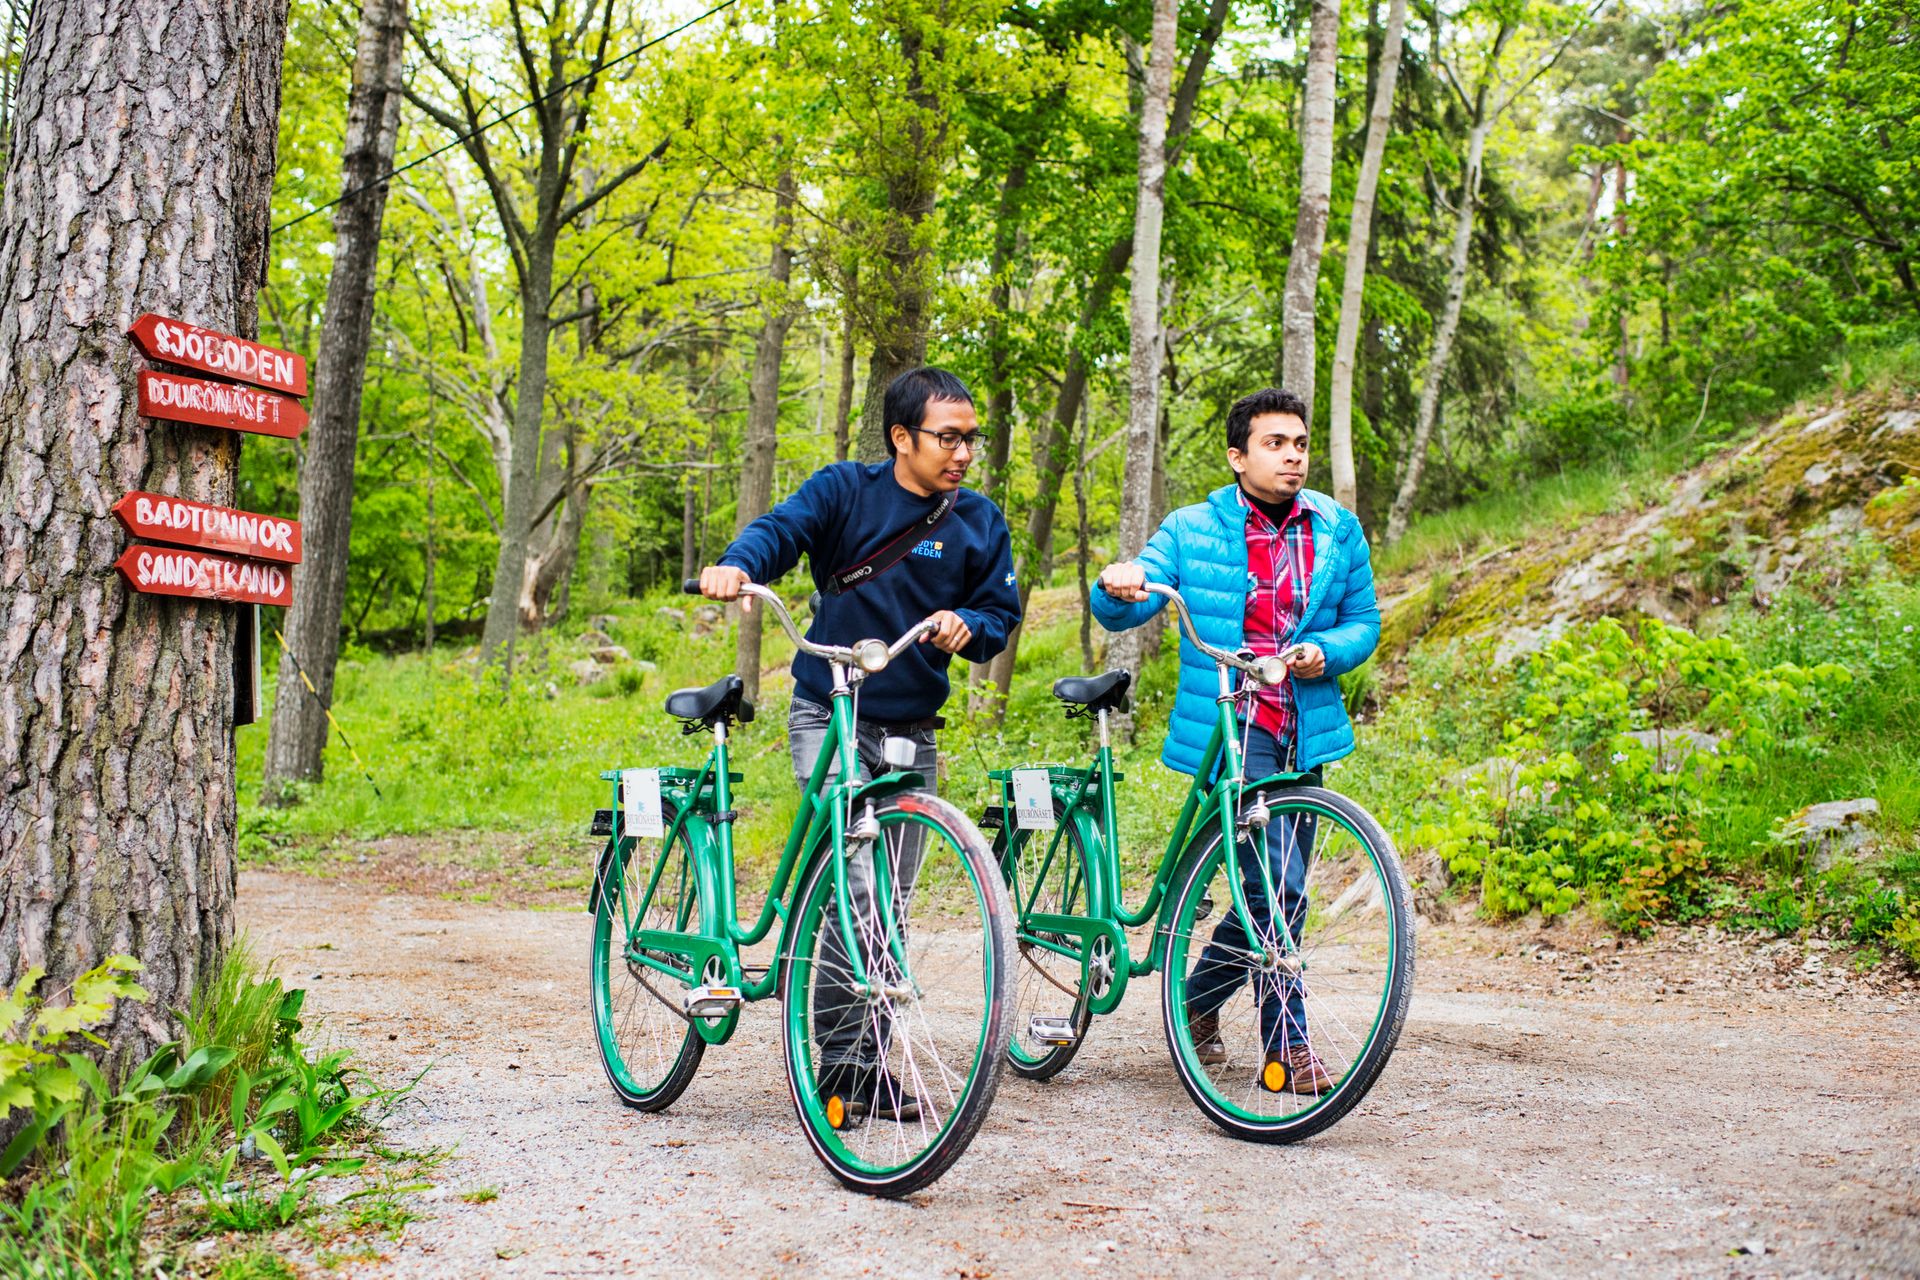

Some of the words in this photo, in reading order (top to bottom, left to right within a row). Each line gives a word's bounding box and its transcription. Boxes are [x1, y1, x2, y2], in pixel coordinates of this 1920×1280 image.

[154, 322, 294, 386] SJÖBODEN
[147, 376, 284, 424] DJURÖNÄSET
[136, 497, 293, 554] BADTUNNOR
[926, 497, 949, 525] Canon
[137, 551, 286, 598] SANDSTRAND
[842, 566, 873, 584] Canon
[911, 546, 942, 559] WEDEN
